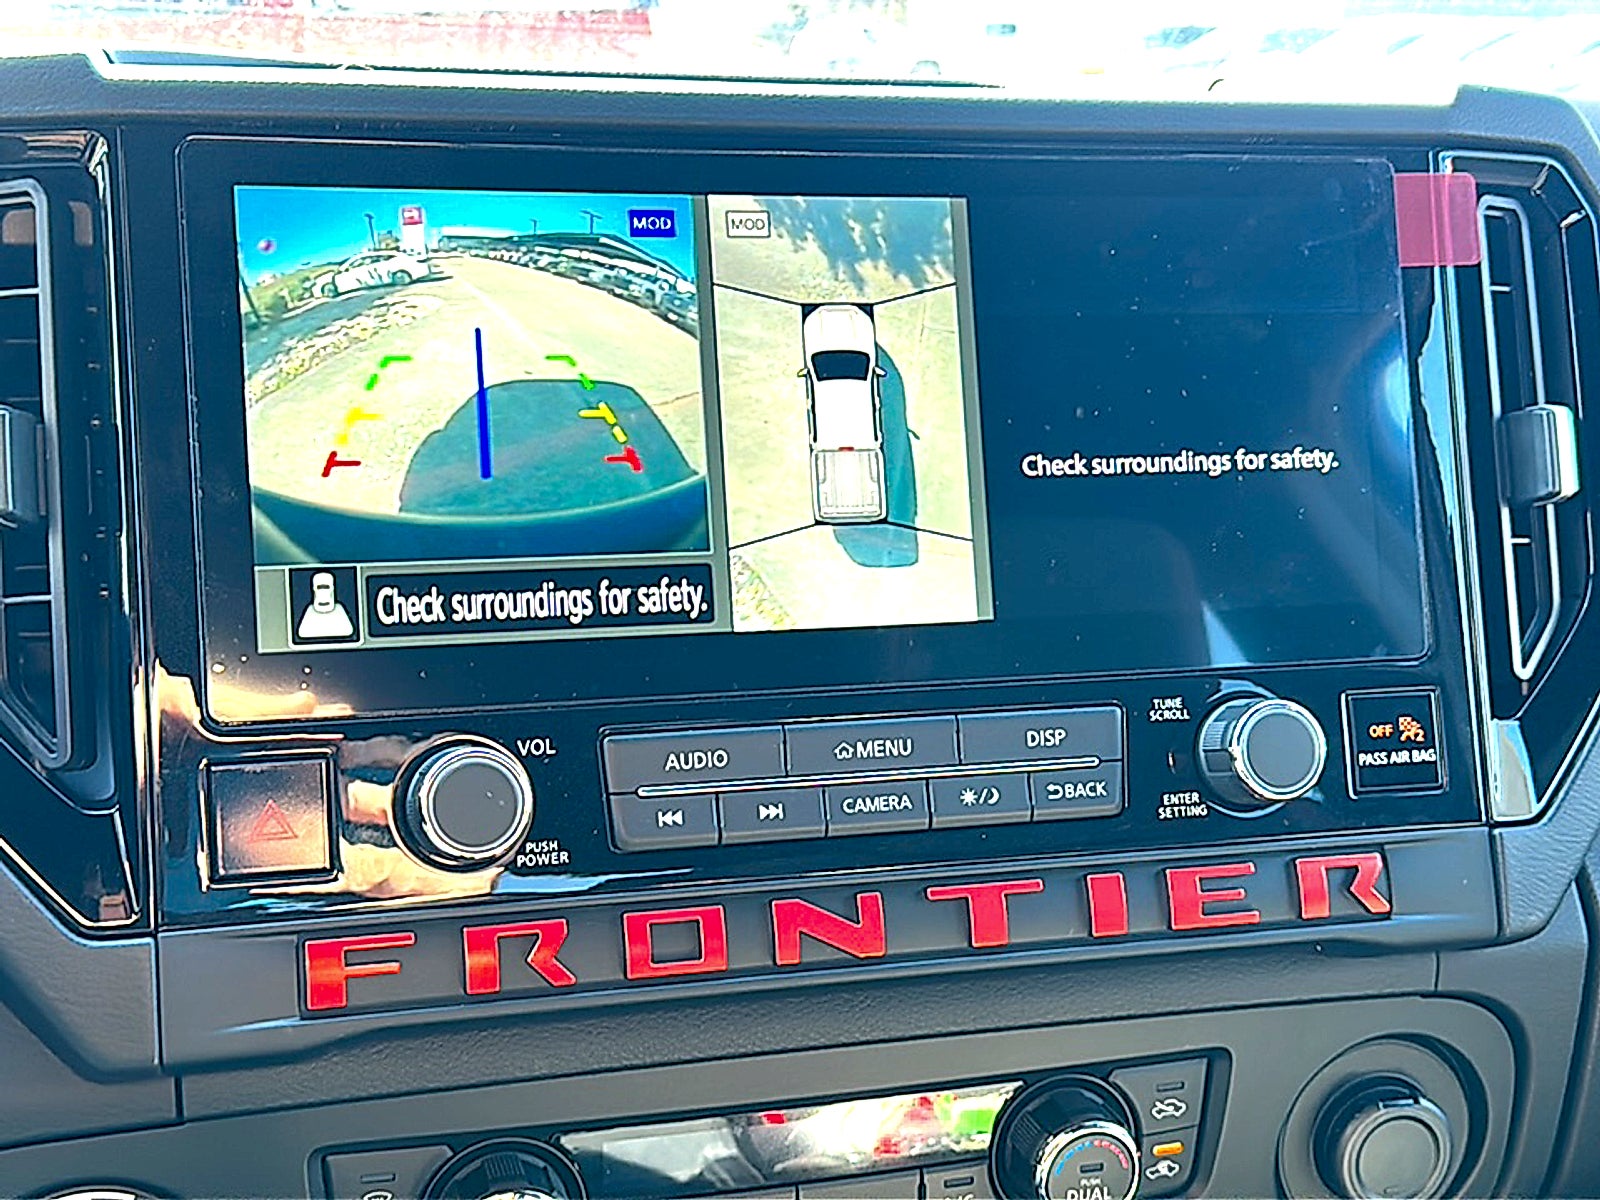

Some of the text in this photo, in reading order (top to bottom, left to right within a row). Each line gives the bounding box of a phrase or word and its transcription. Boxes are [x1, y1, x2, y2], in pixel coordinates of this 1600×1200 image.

[633, 217, 671, 229] MOD
[731, 218, 766, 230] MOD
[1022, 446, 1339, 476] Check surroundings for safety.
[376, 576, 708, 624] Check surroundings for safety.
[1153, 697, 1183, 709] TUNE
[1149, 709, 1191, 721] SCROLL
[1027, 728, 1067, 747] DISP
[1369, 724, 1394, 738] OFF
[517, 738, 557, 756] VOL
[856, 738, 913, 758] MENU
[664, 749, 729, 772] AUDIO
[1358, 748, 1437, 766] PASS AIR BAG
[1065, 781, 1108, 799] BACK
[1163, 792, 1200, 805] ENTER
[842, 794, 913, 814] CAMERA
[1158, 804, 1208, 819] SETTING
[525, 840, 559, 854] PUSH
[516, 851, 570, 868] POWER
[304, 851, 1392, 1011] FRONTIER
[1067, 1186, 1111, 1200] DUAL
